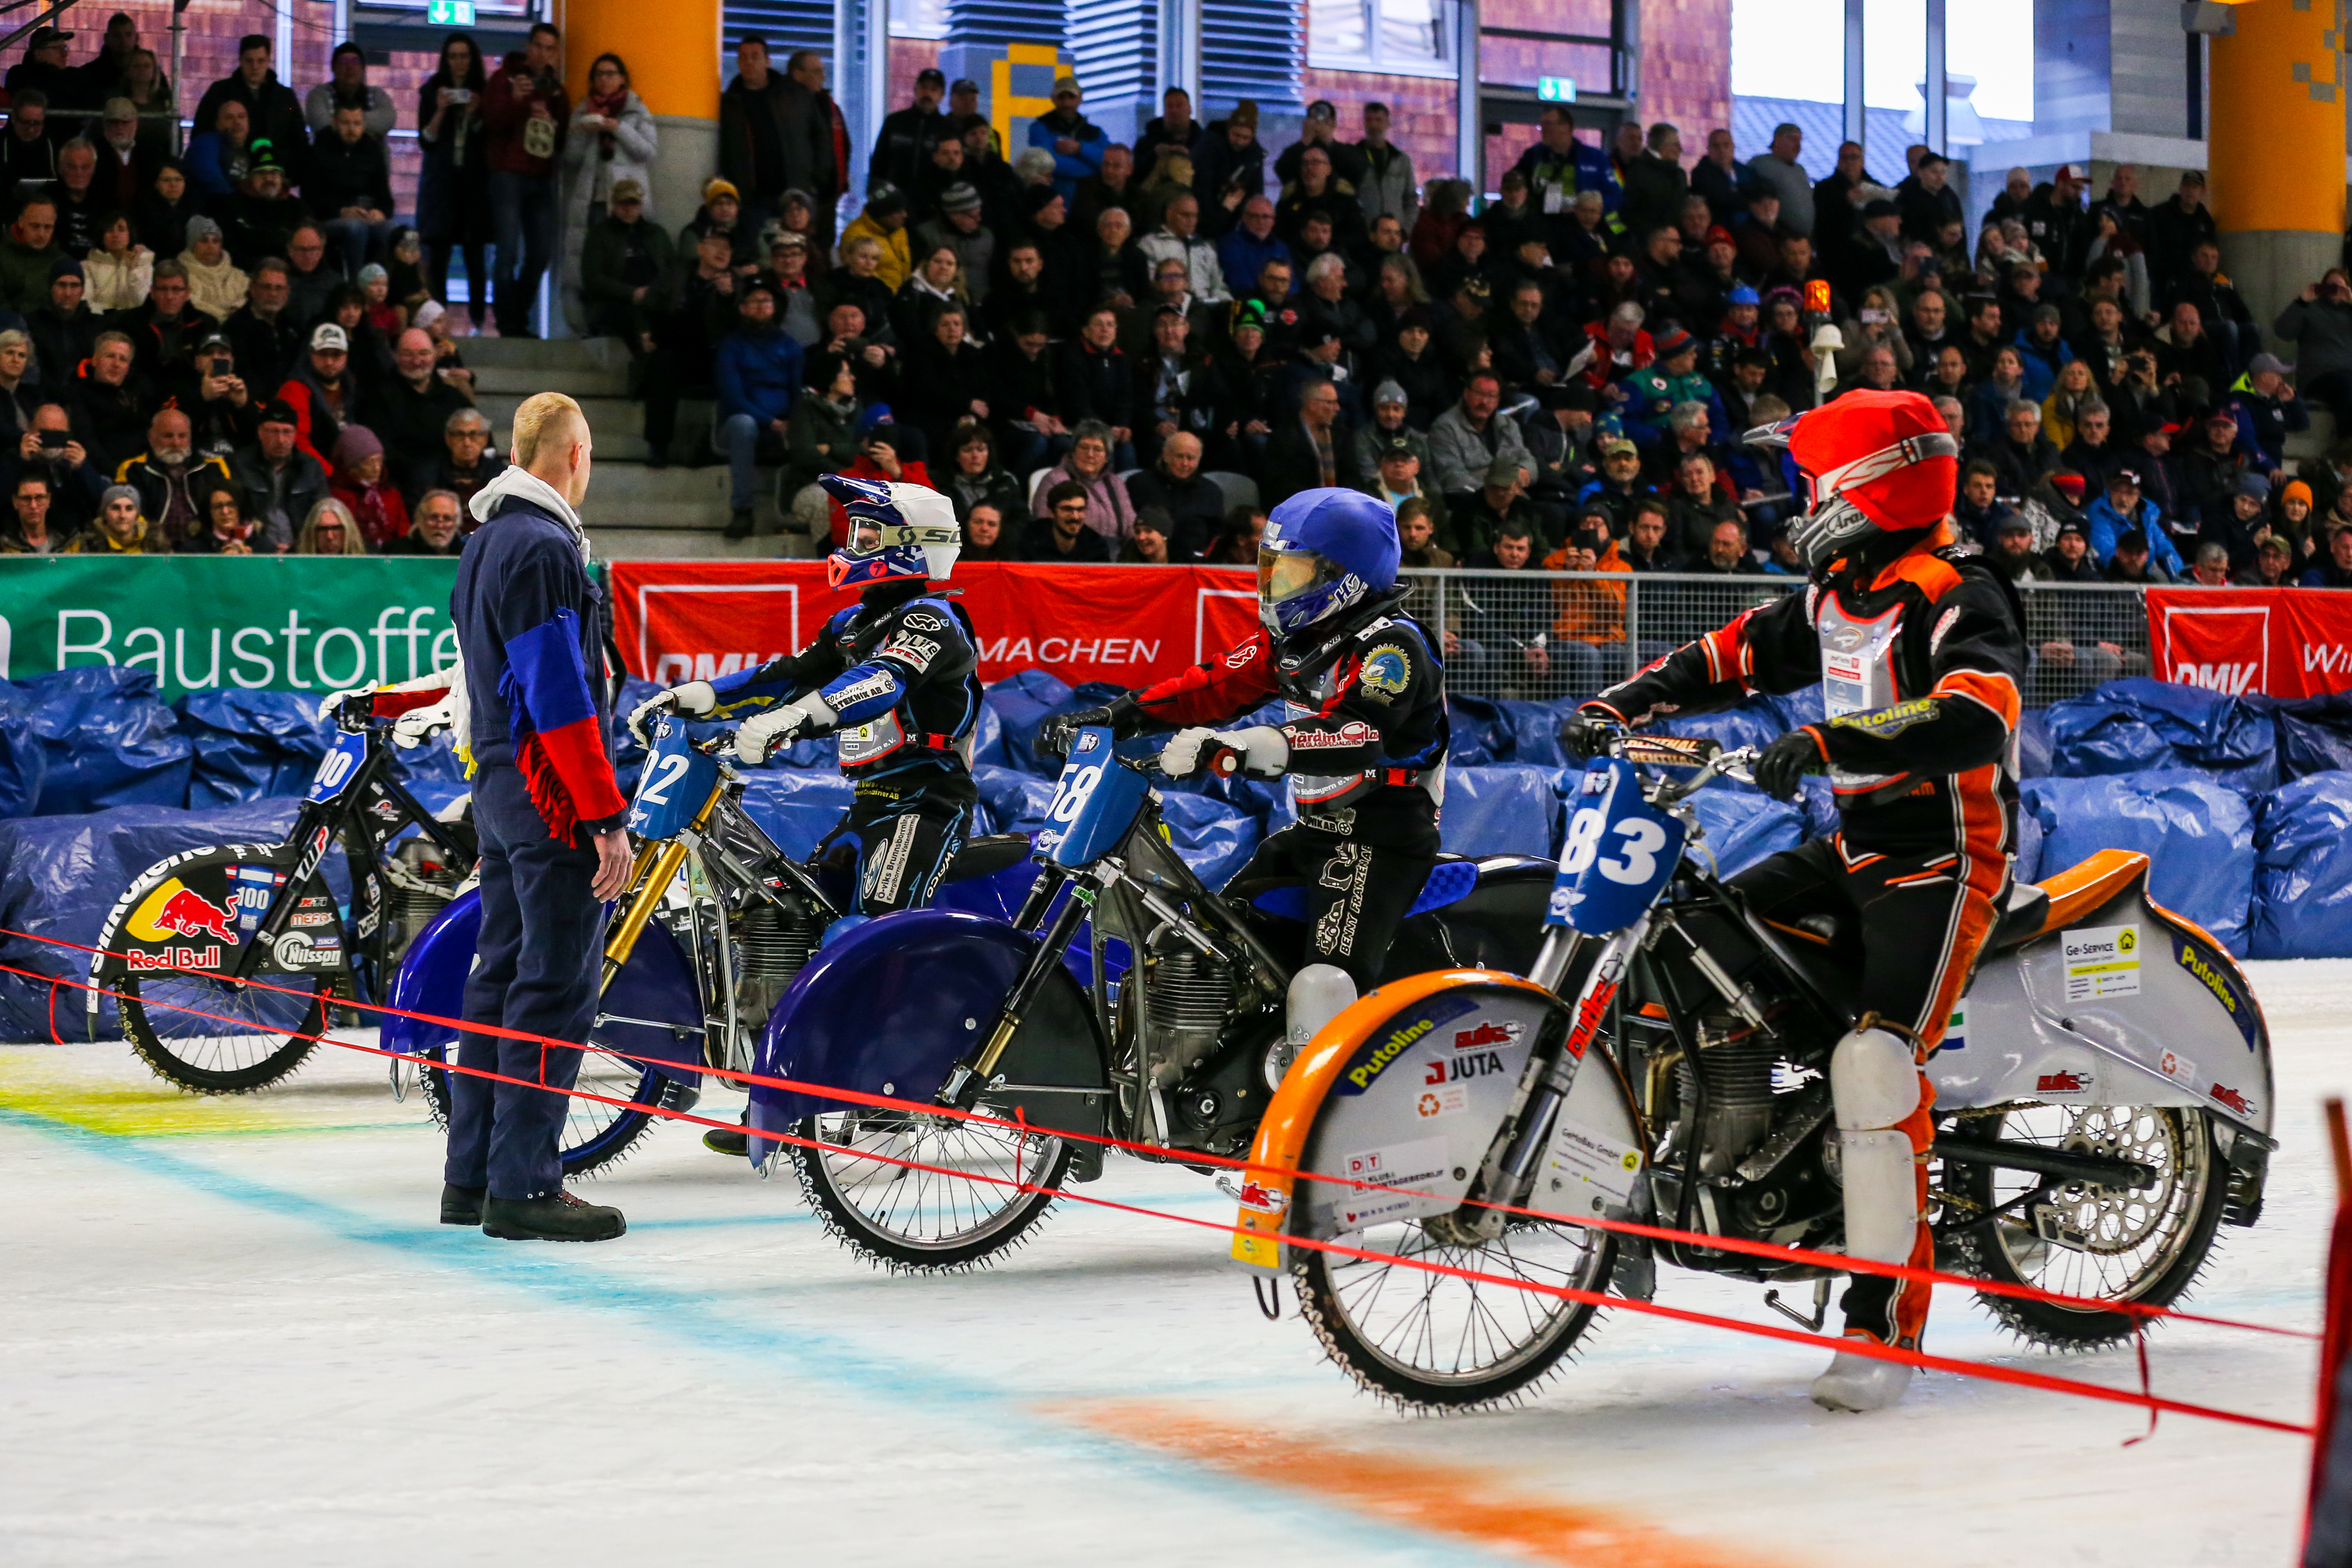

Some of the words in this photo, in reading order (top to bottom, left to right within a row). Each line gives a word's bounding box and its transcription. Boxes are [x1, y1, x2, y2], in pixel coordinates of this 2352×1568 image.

[977, 637, 1161, 663] MACHEN
[870, 687, 883, 697] AB
[1300, 782, 1338, 795] Südbayern
[1338, 774, 1353, 786] e.V.
[1365, 769, 1376, 778] M
[1324, 821, 1337, 832] AB
[1559, 808, 1666, 885] 83
[236, 886, 270, 910] 100
[1340, 912, 1358, 956] BENNY
[128, 948, 173, 970] Red
[177, 947, 220, 968] Bull
[287, 948, 342, 963] Nilsson
[2181, 945, 2236, 1012] Putoline
[1348, 1019, 1434, 1087] Putoline
[1450, 1052, 1505, 1081] JUTA
